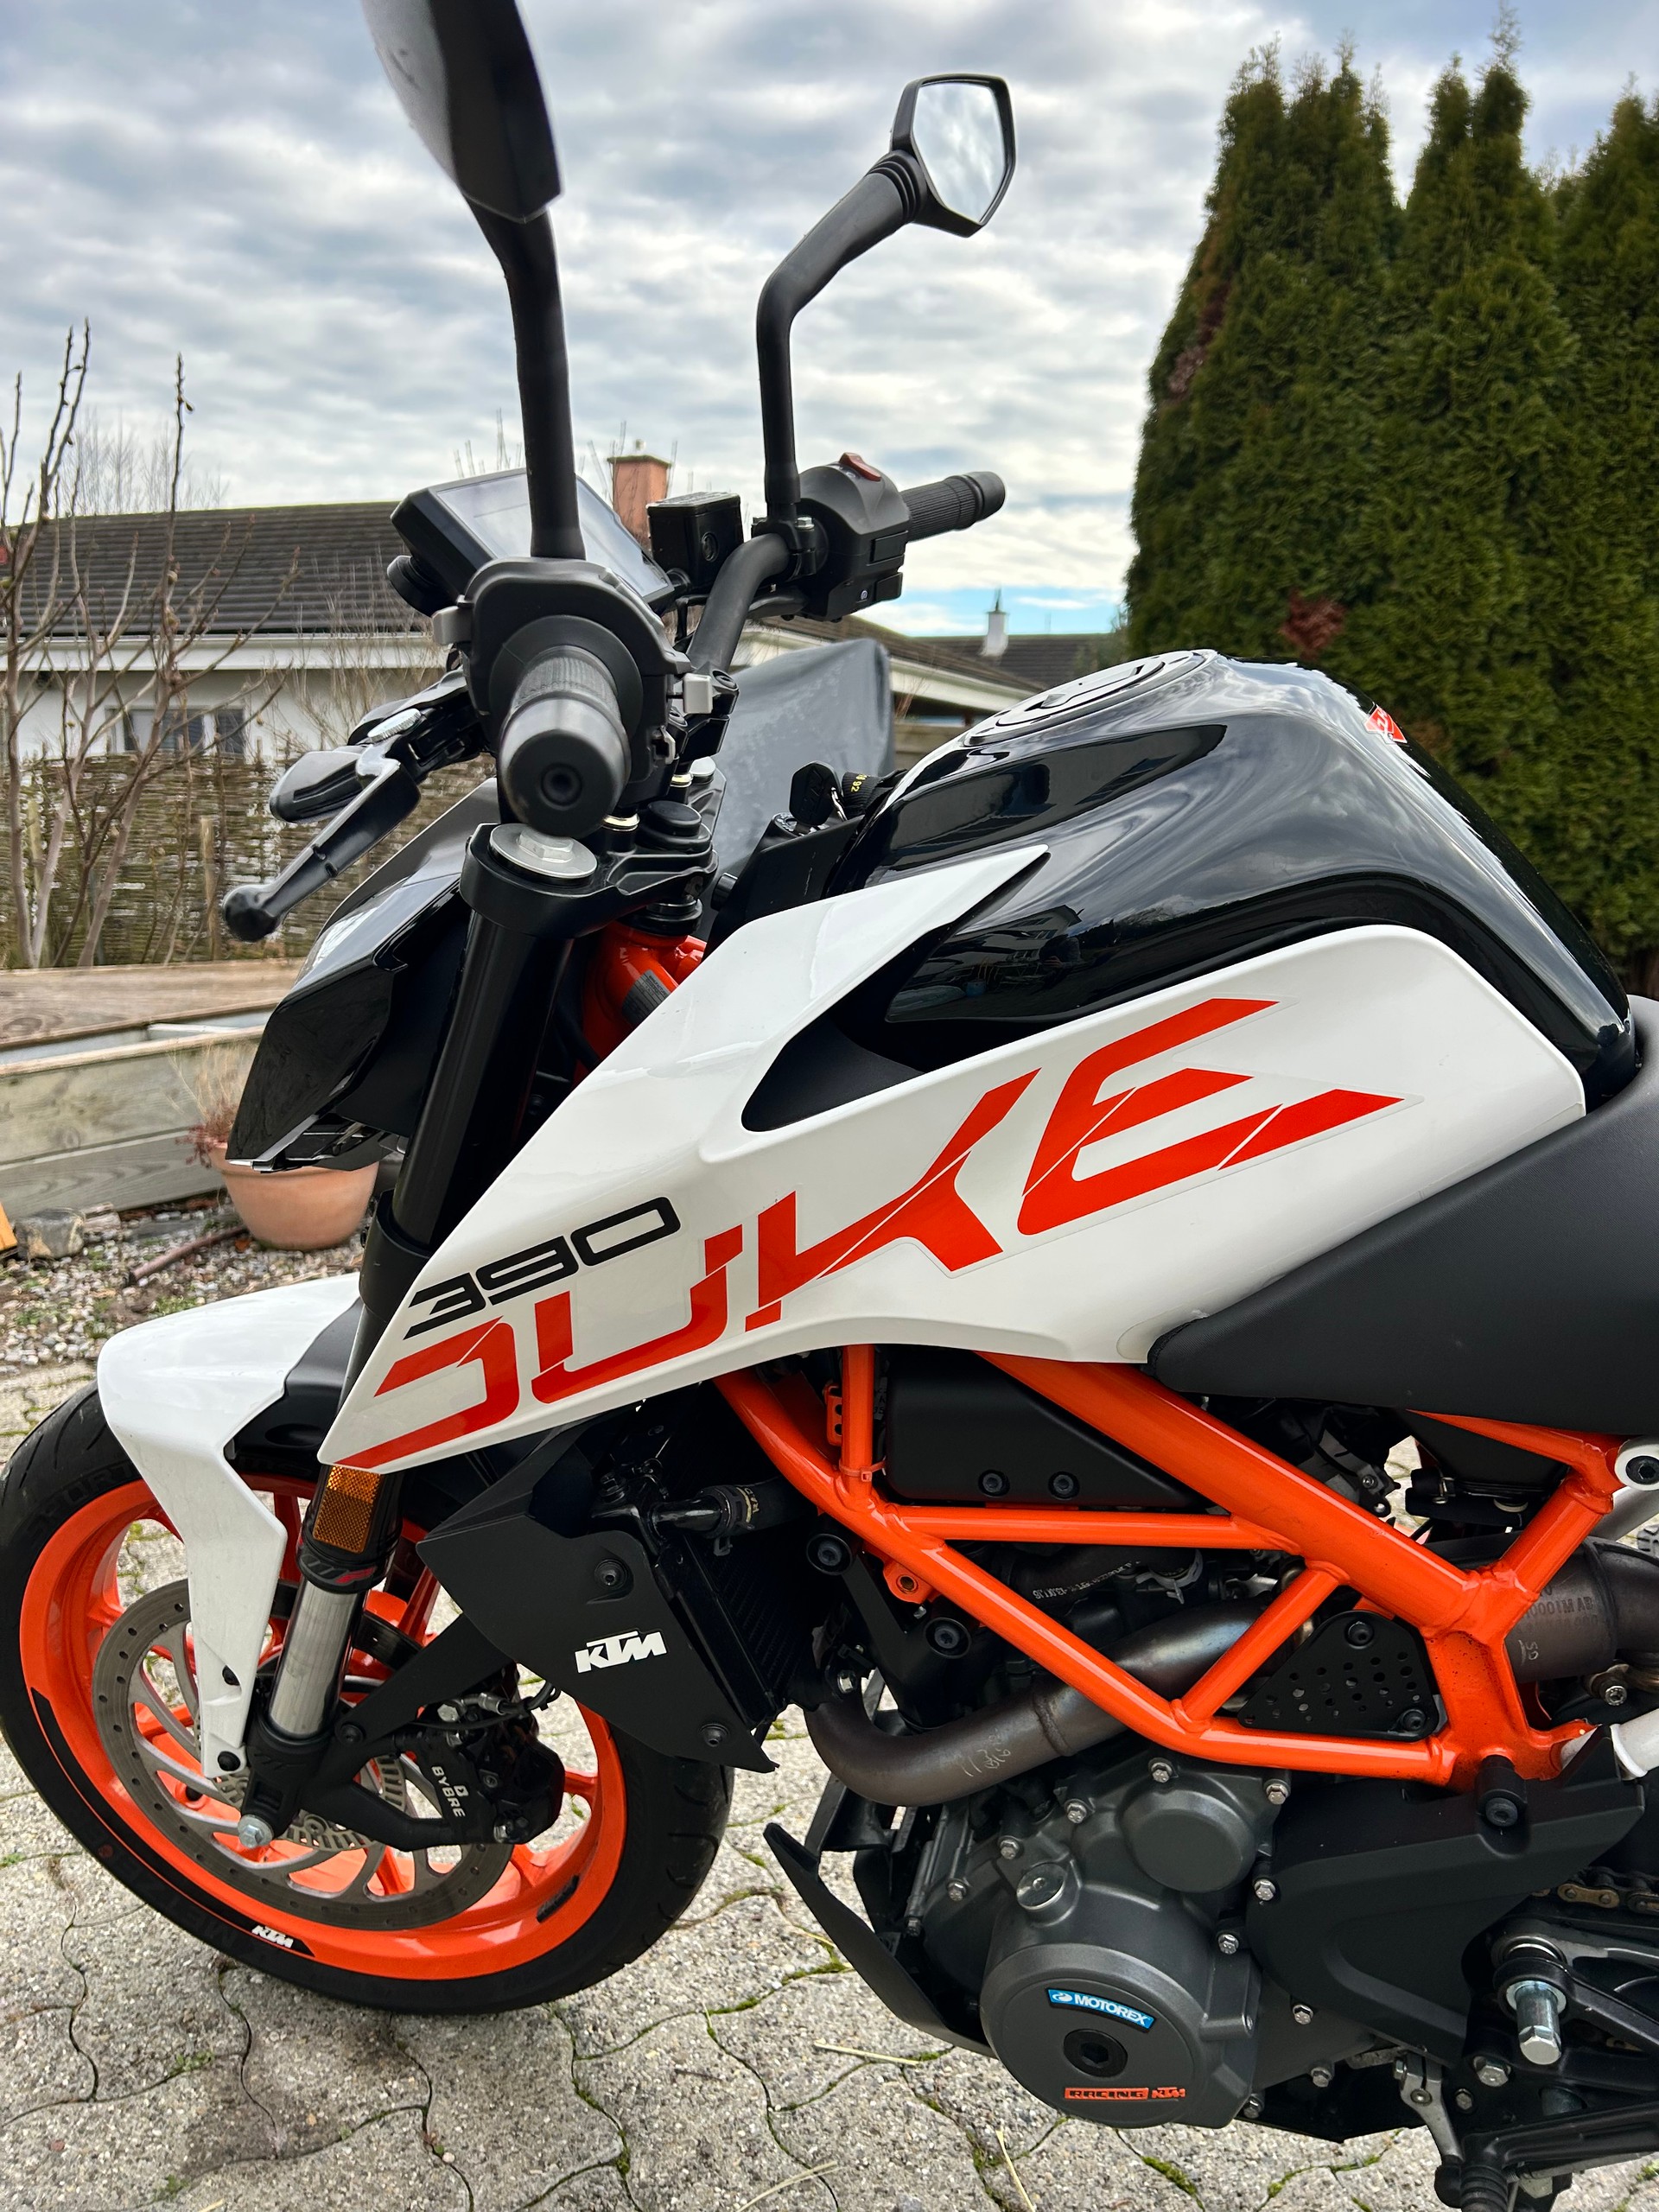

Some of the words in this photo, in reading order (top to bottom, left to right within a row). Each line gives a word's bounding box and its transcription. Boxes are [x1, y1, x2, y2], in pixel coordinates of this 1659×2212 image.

[335, 999, 1402, 1469] DUKE
[405, 1197, 681, 1339] 390
[575, 1630, 667, 1673] KTM
[431, 1766, 466, 1818] BYBRE
[251, 1925, 294, 1948] KTM
[1074, 1993, 1149, 2026] MOTOREX
[1068, 2089, 1145, 2099] RACING
[1151, 2087, 1185, 2099] KTM
